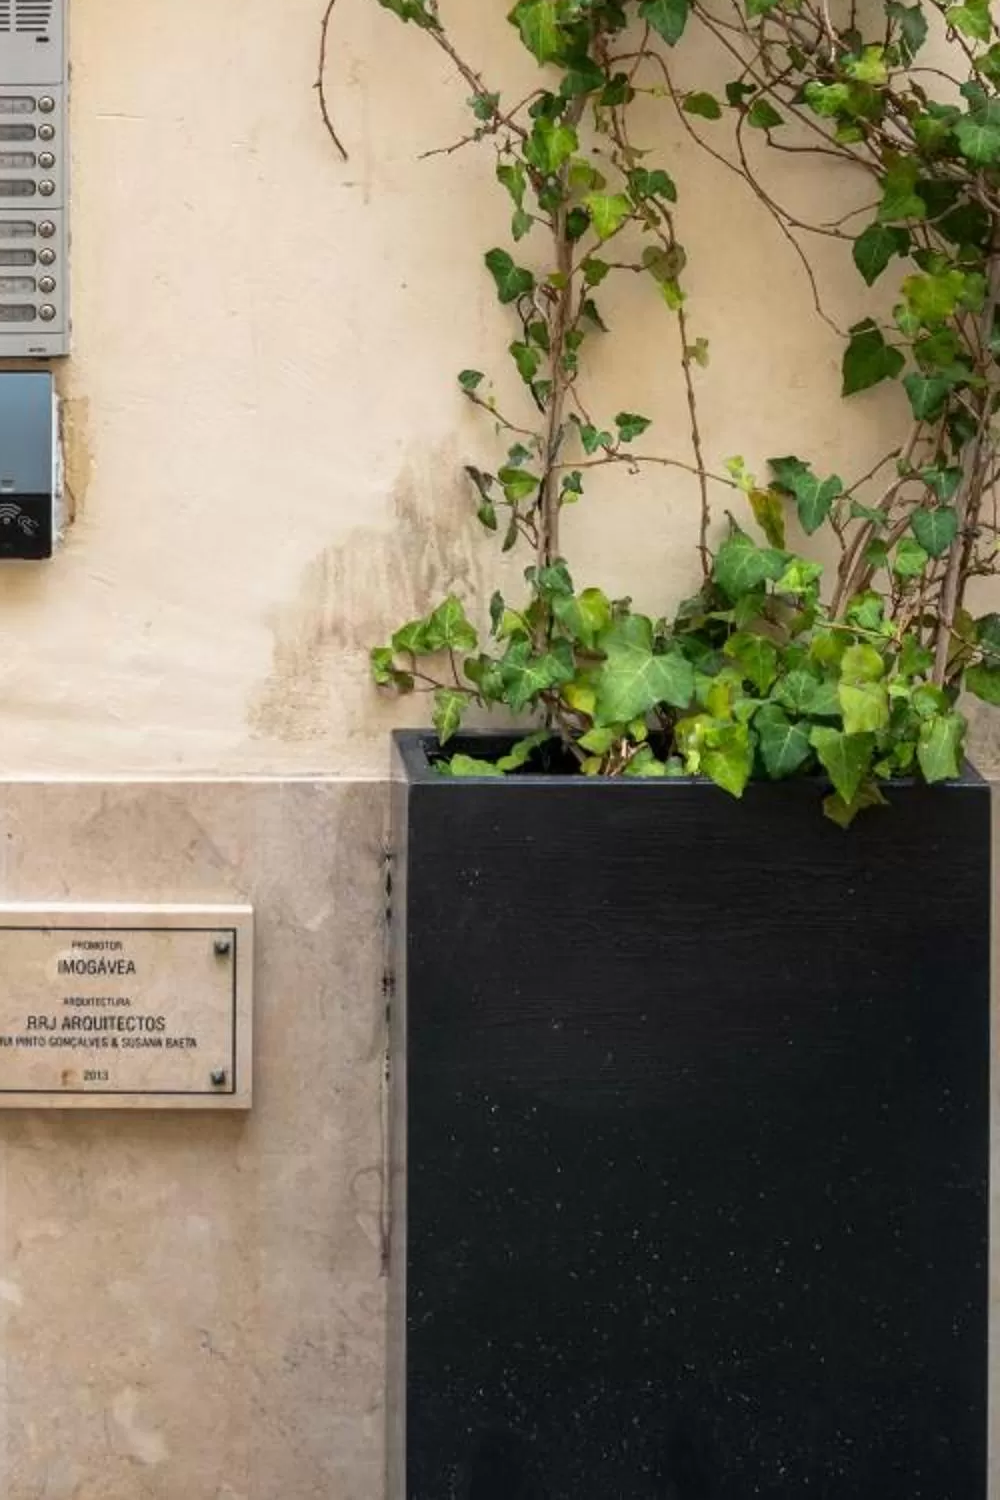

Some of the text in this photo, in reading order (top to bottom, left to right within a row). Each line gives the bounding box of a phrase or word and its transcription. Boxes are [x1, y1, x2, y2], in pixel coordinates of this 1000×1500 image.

[71, 940, 122, 950] PROMOTOR
[58, 957, 136, 975] IMOGÁVEA
[27, 1015, 165, 1031] RRJ ARQUITECTOS
[48, 1036, 109, 1050] GONÇALVES
[121, 1037, 163, 1049] SUSANA
[83, 1070, 108, 1081] 2013
